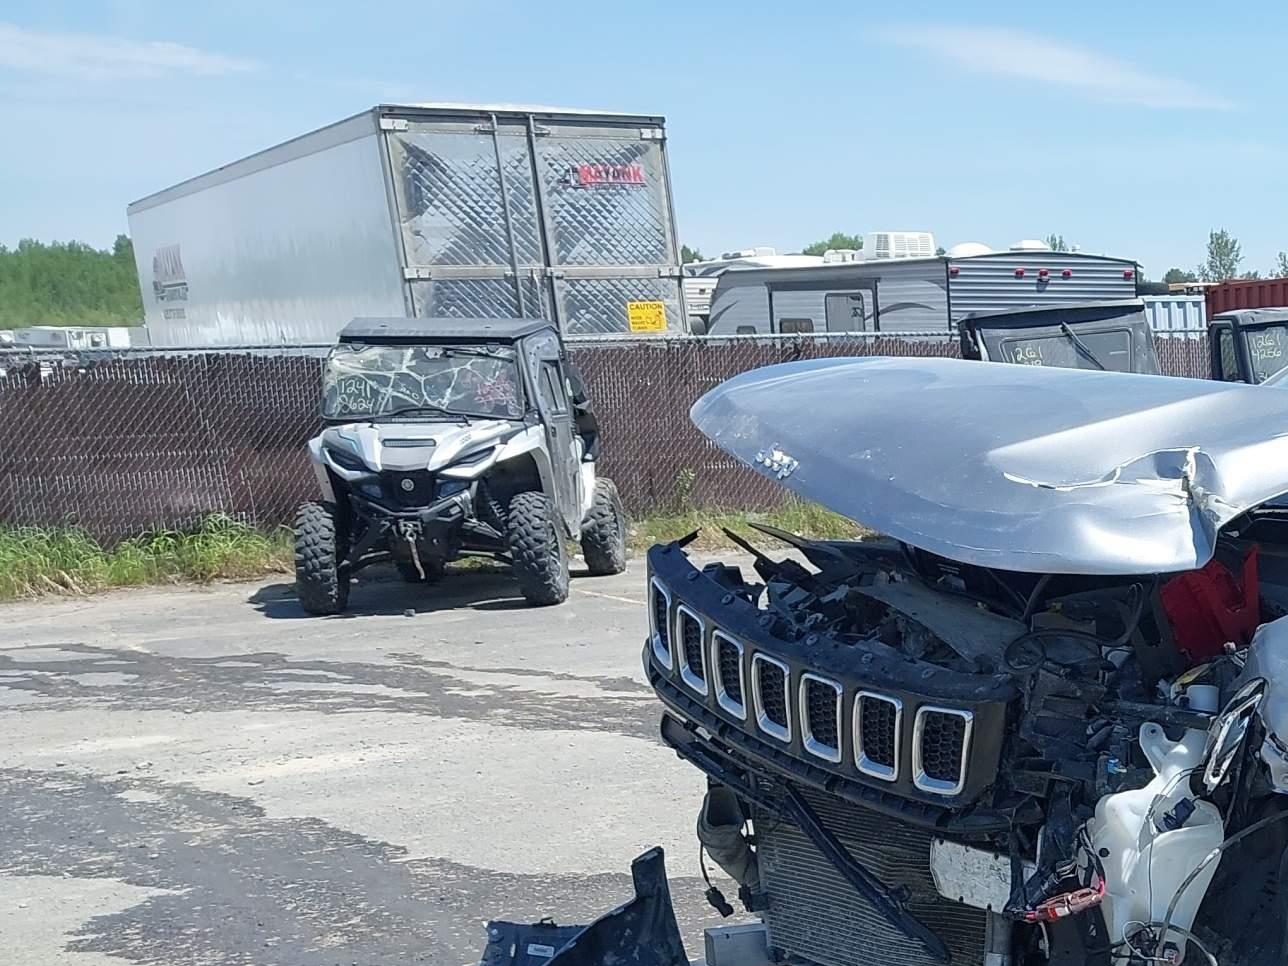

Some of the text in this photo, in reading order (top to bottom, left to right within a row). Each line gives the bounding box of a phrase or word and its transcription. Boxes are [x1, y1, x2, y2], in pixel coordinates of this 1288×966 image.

[629, 303, 663, 311] CAUTION
[1252, 333, 1281, 350] 1261
[341, 379, 371, 398] 1241
